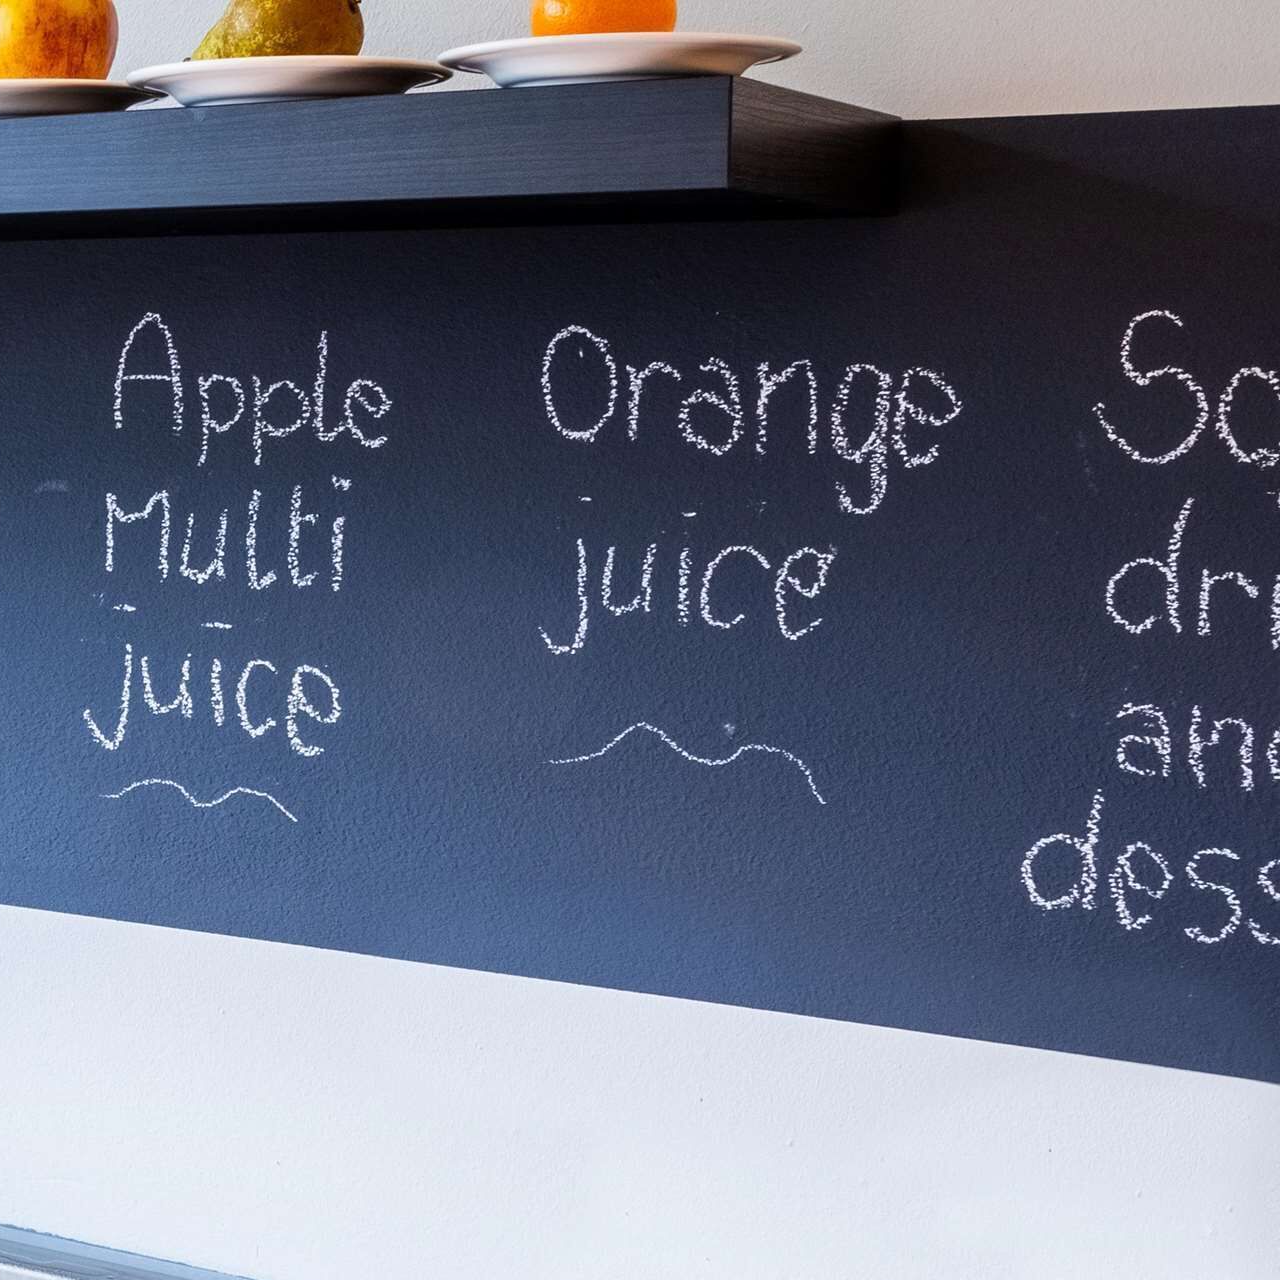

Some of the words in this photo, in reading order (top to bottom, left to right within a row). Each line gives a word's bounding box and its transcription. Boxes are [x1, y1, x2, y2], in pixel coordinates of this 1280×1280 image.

[113, 311, 394, 467] Apple
[541, 324, 963, 515] Orange
[105, 475, 352, 591] Multi
[538, 495, 839, 655] juice
[1116, 702, 1280, 792] an
